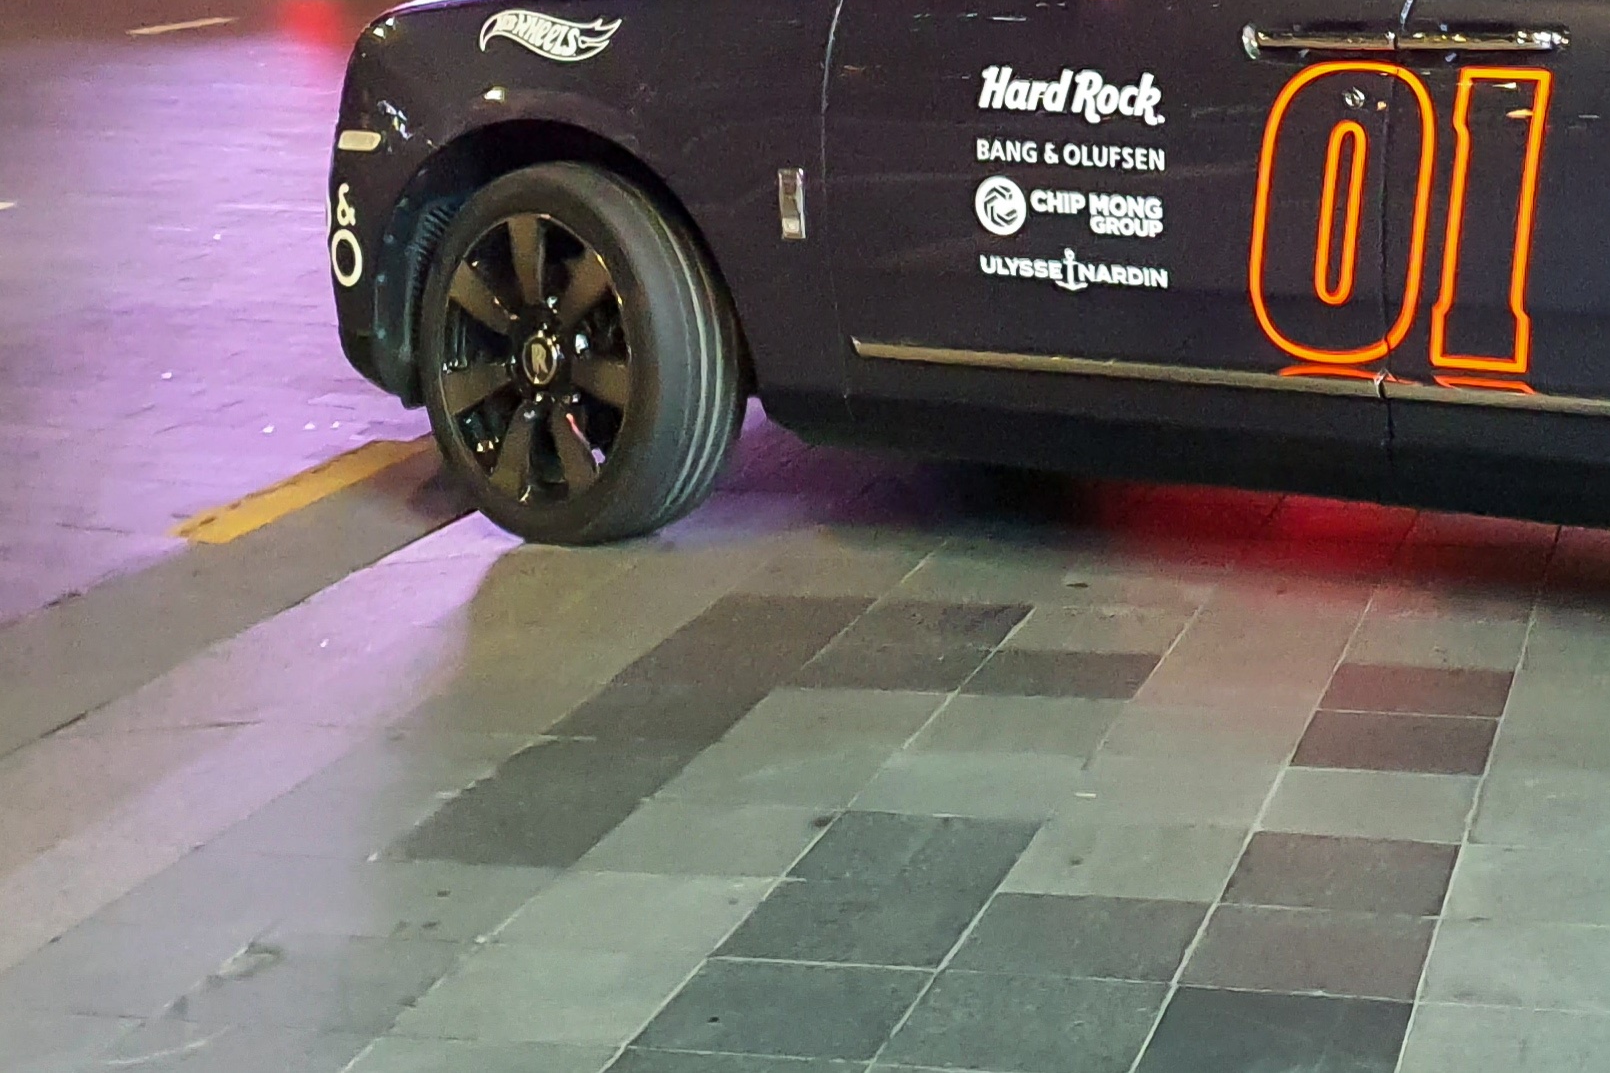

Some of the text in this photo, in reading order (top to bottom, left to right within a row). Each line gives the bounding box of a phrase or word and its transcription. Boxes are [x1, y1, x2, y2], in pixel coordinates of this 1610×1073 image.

[978, 65, 1074, 113] Hard
[976, 137, 1166, 172] BANG & OLUFSEN
[1029, 188, 1164, 220] CHIP MONG
[1249, 60, 1556, 374] 01
[1089, 214, 1164, 238] GROUP
[979, 253, 1169, 290] ULYSSE NARDIN
